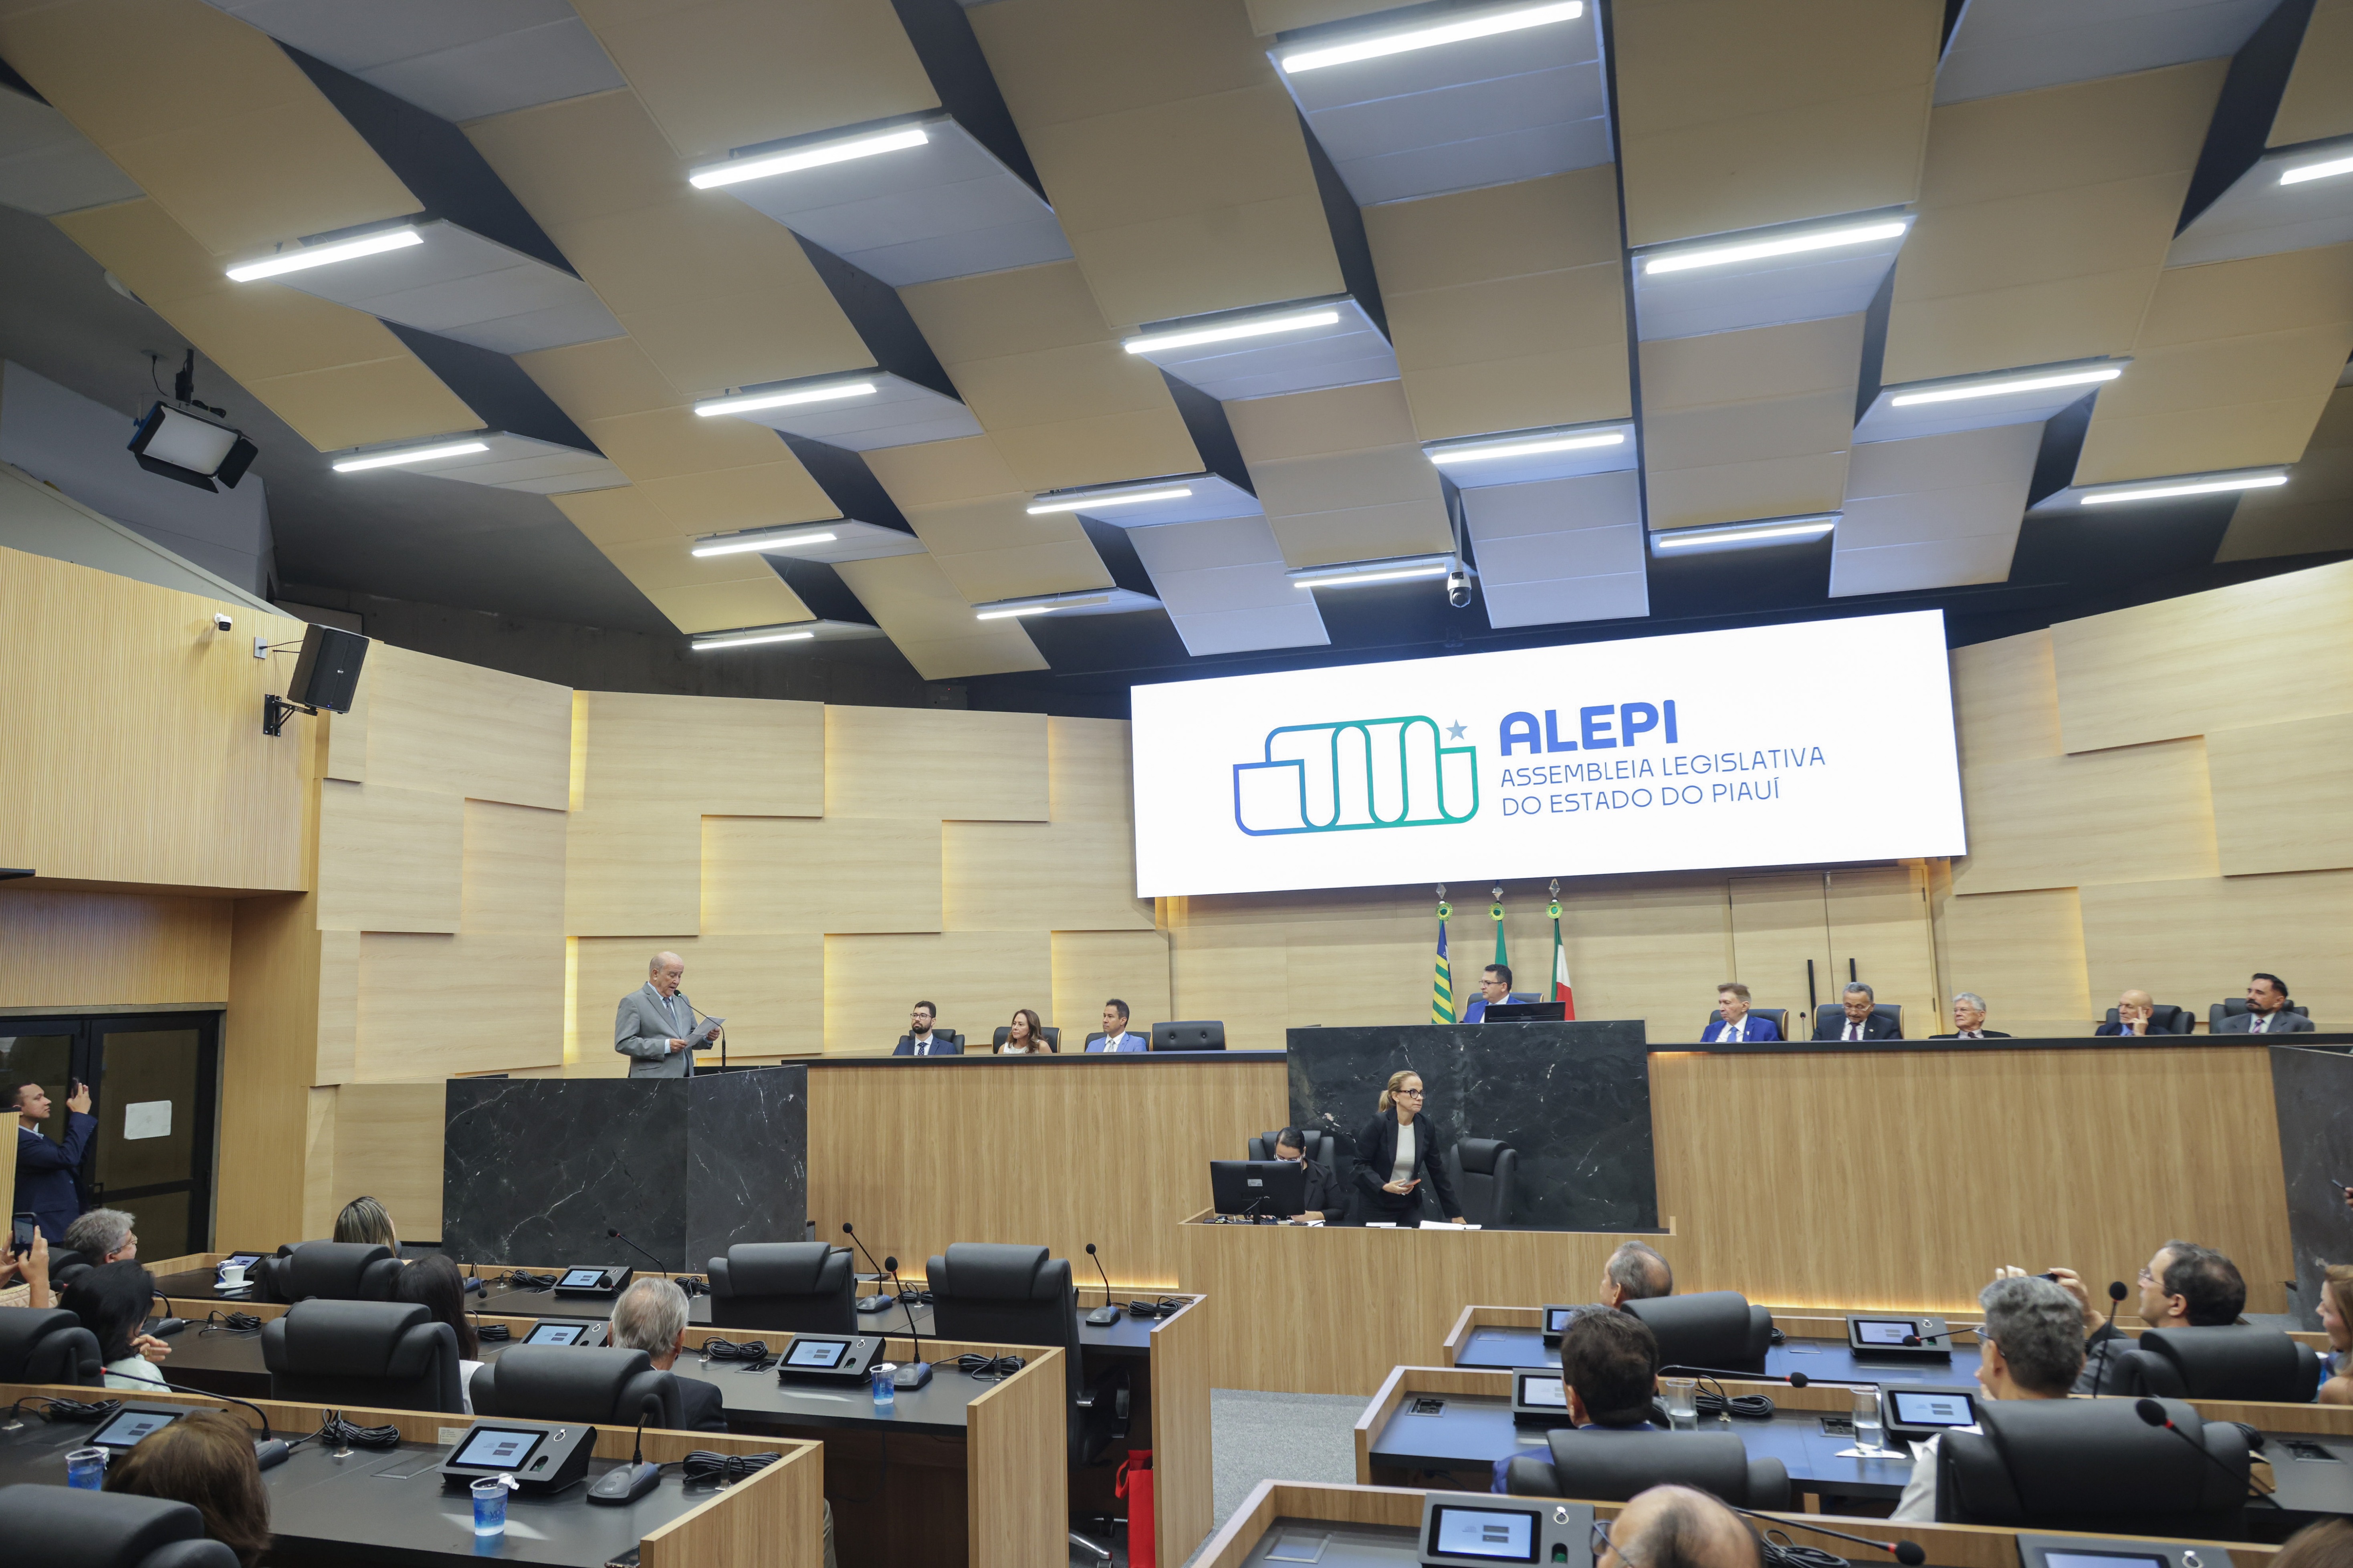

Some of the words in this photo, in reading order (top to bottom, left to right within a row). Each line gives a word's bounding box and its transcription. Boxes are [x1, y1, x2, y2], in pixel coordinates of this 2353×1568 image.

[1499, 699, 1678, 756] ALEPI
[1501, 759, 1654, 788] ASSEMBLEIA
[1663, 746, 1826, 776] LEGISLATIVA
[1503, 796, 1542, 816] DO
[1550, 788, 1652, 813] ESTADO
[1662, 785, 1703, 806] DO
[1712, 776, 1780, 803] PIAUÍ
